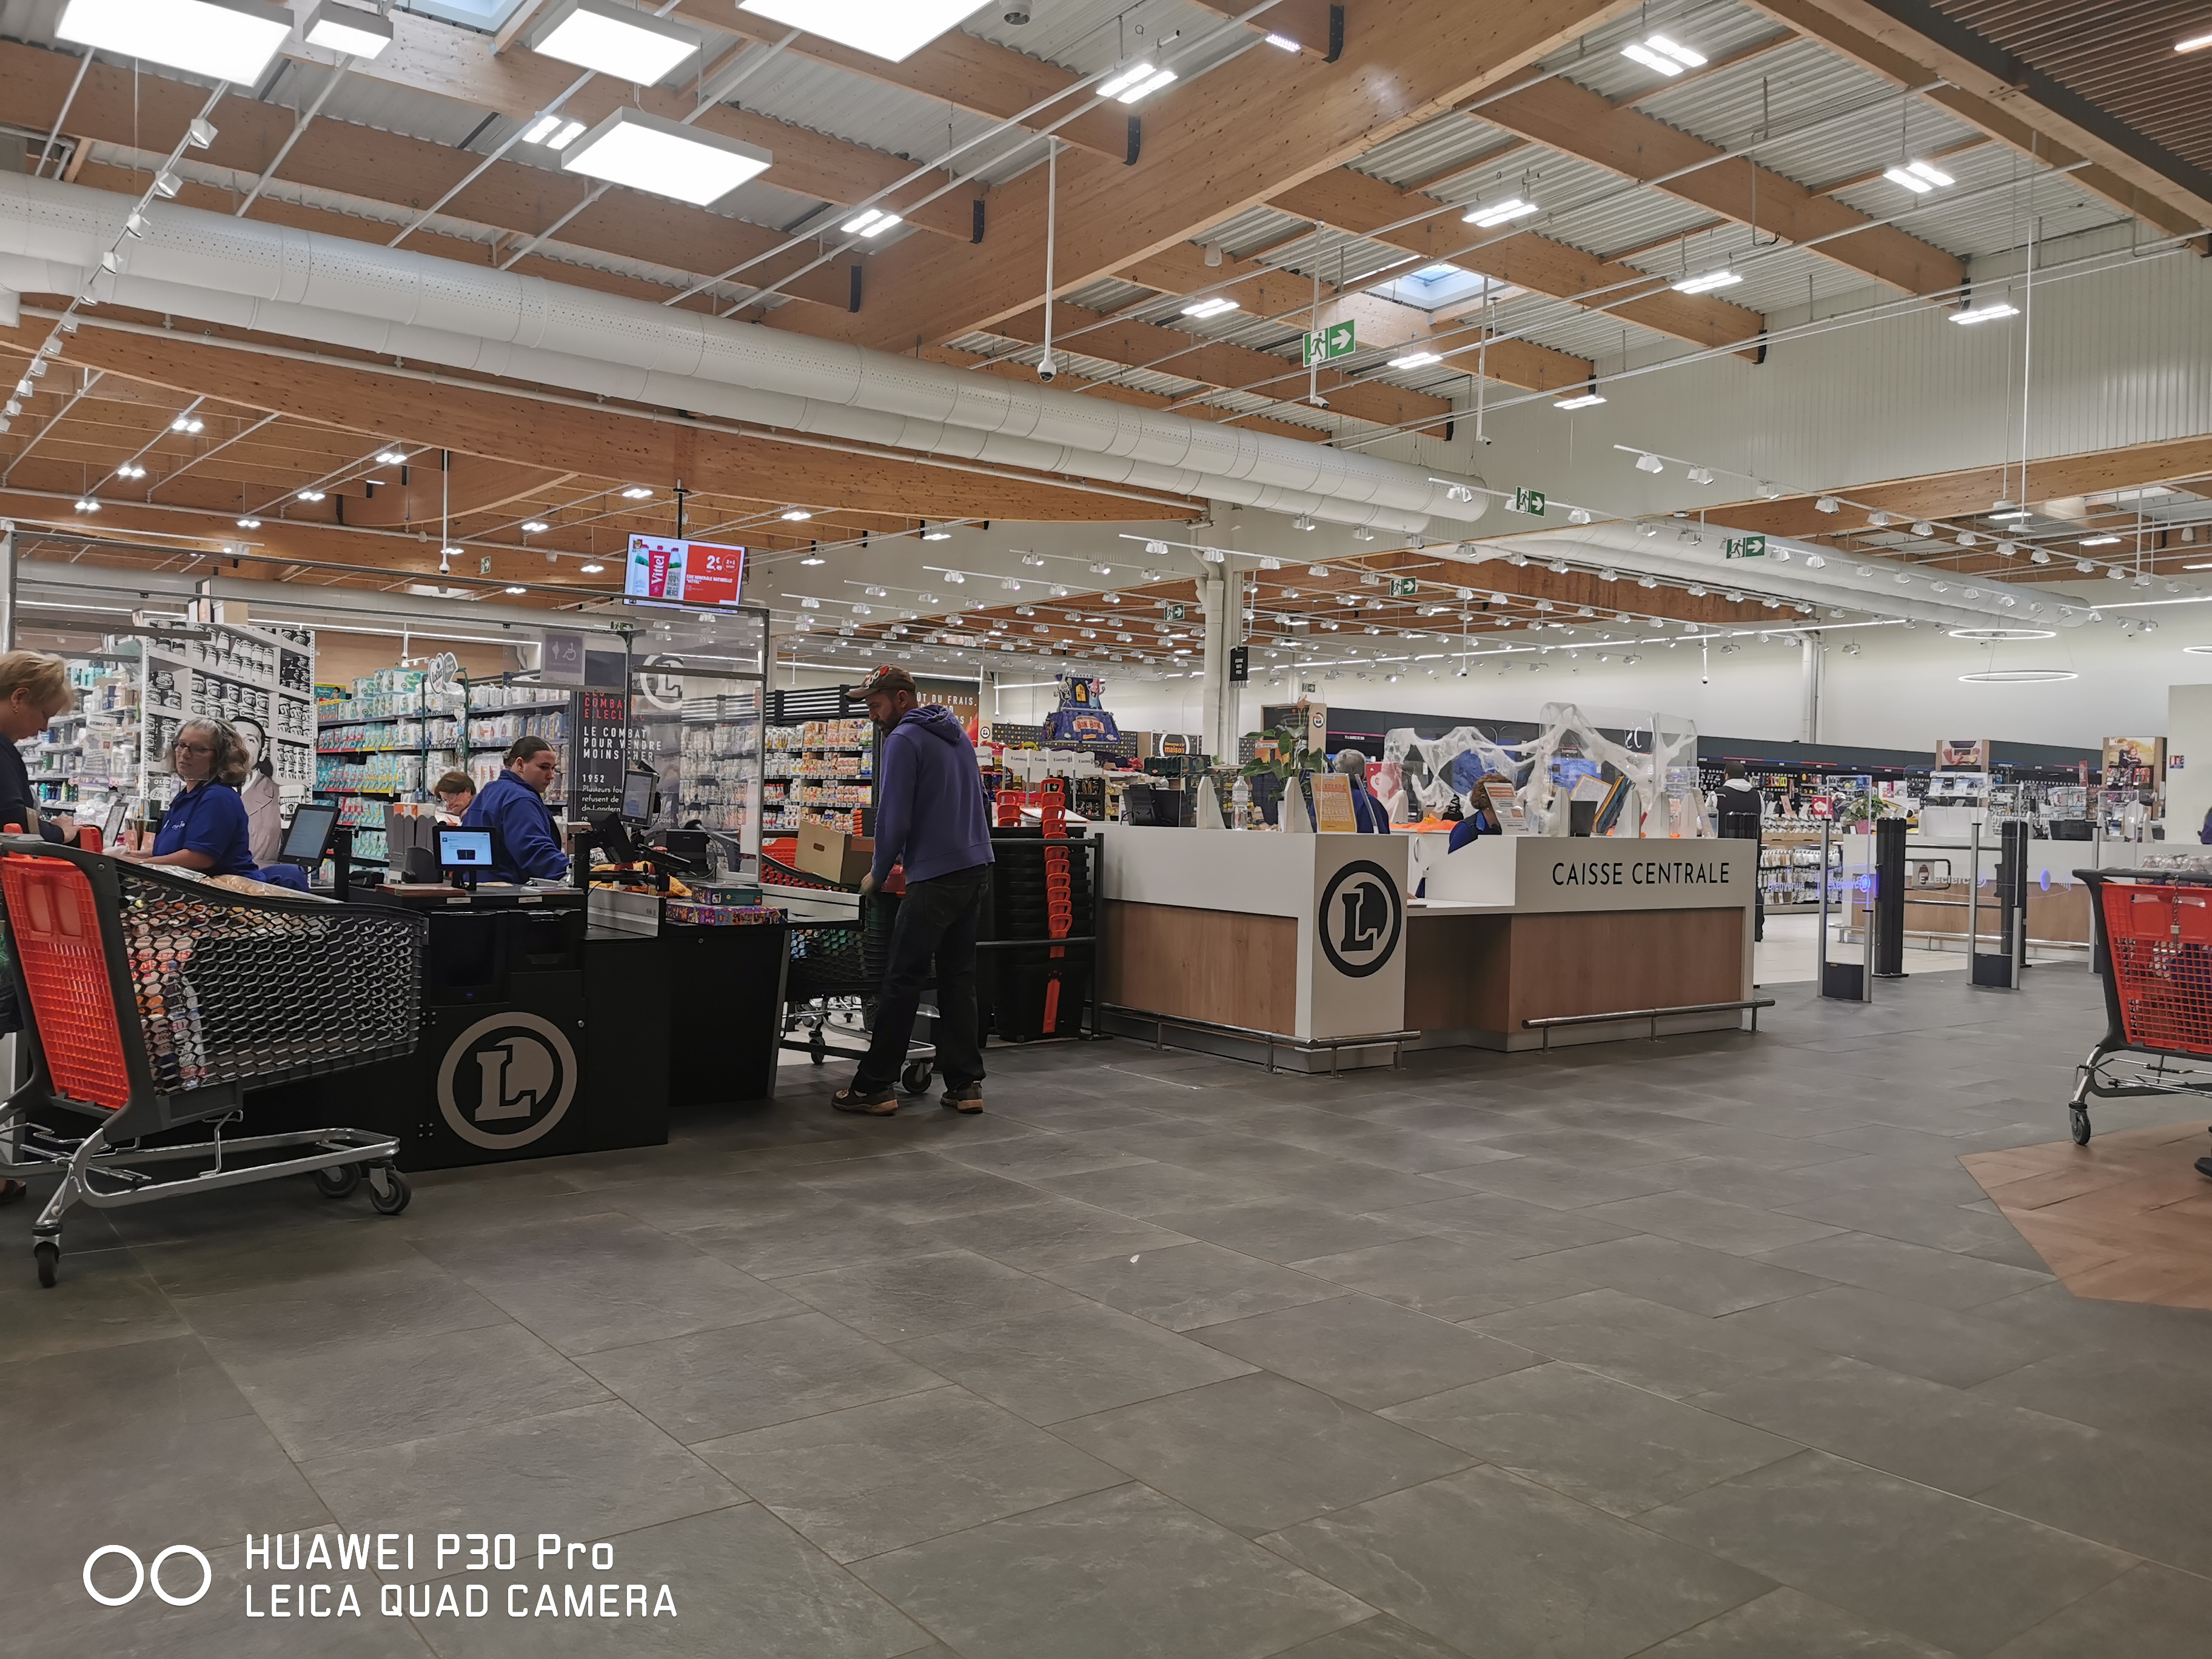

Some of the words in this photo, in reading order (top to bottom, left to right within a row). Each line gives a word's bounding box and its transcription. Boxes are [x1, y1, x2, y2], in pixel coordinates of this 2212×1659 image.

[651, 554, 665, 585] Vittel
[931, 694, 942, 703] DU
[947, 695, 977, 706] FRAIS.
[583, 725, 597, 737] LE
[603, 726, 647, 740] COMBAT
[583, 737, 613, 749] POUR
[583, 748, 620, 760] MOINS
[582, 774, 605, 783] 1952
[582, 785, 611, 793] Plusieurs
[1552, 862, 1623, 885] CAISSE
[1632, 862, 1729, 885] CENTRALE
[1919, 875, 1971, 885] E.Leclerc
